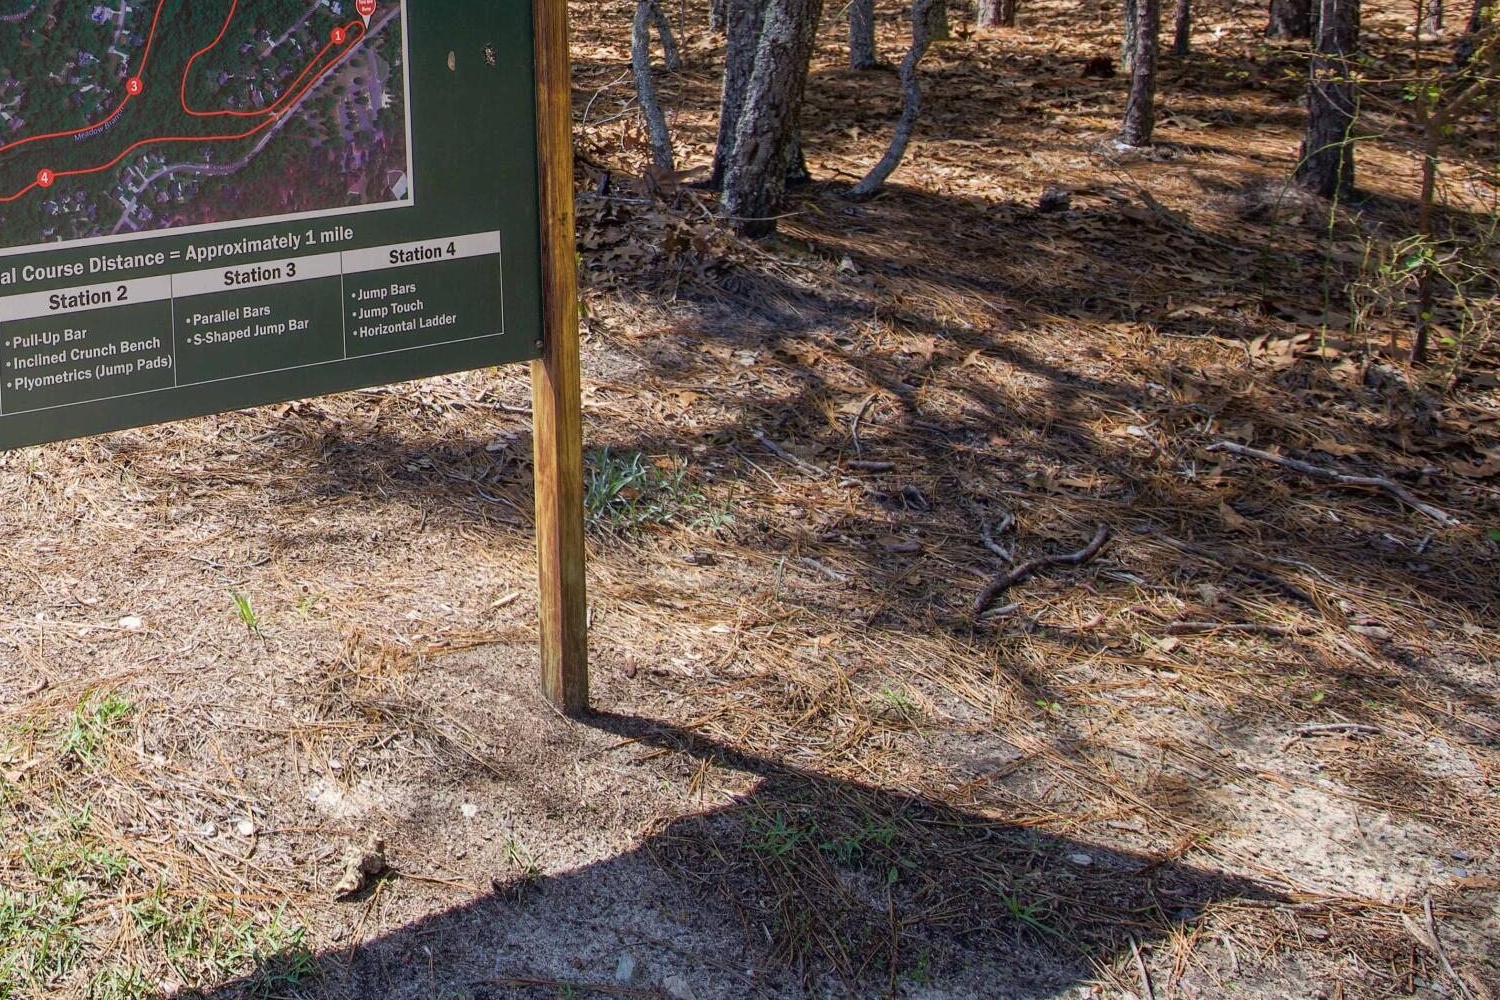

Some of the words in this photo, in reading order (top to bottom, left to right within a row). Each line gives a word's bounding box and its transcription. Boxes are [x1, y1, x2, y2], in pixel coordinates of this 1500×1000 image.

[74, 126, 104, 142] Meadow
[22, 263, 84, 282] Course
[89, 252, 165, 273] Distance
[185, 232, 301, 262] Approximately
[305, 229, 316, 245] 1
[320, 226, 353, 243] mile
[389, 246, 442, 264] Station
[446, 241, 456, 256] 4
[224, 267, 281, 286] Station
[286, 262, 296, 277] 3
[49, 290, 112, 310] Station
[117, 285, 128, 301] 2
[357, 287, 388, 301] Jump
[390, 283, 416, 296] Bars
[193, 308, 240, 326] Parallel
[243, 306, 271, 319] Bars
[358, 306, 388, 320] Jump
[391, 300, 424, 314] Touch
[193, 326, 250, 346] S-Shaped
[254, 323, 285, 337] Jump
[288, 318, 310, 330] Bar
[359, 318, 416, 338] Horizontal
[419, 314, 457, 328] Ladder
[13, 332, 60, 349] Pull-Up
[64, 328, 87, 341] Bar
[14, 350, 66, 369] Inclined
[70, 343, 117, 361] Crunch
[120, 336, 161, 353] Bench
[14, 369, 93, 391] Plyometrics
[95, 361, 134, 380] (Jump
[137, 354, 173, 371] Pads)
